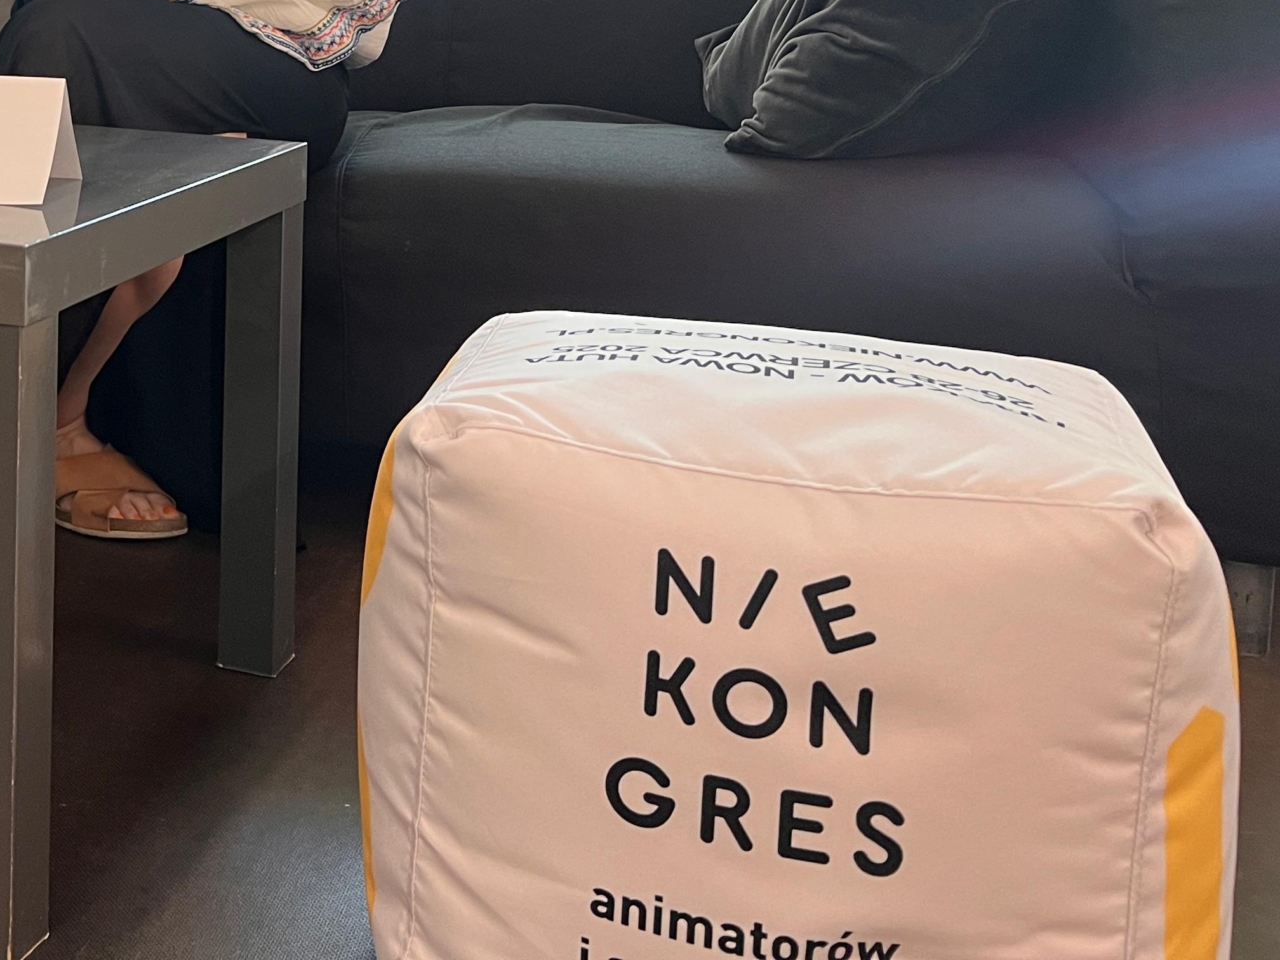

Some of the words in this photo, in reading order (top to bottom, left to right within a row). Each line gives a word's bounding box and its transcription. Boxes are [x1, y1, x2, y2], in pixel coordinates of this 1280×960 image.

[524, 353, 640, 364] HUTA
[552, 344, 648, 353] 2025
[660, 347, 897, 374] CZERWCA
[651, 354, 796, 380] NOWA
[643, 649, 875, 756] KON
[605, 757, 905, 878] GRES
[589, 887, 902, 960] animatorów
